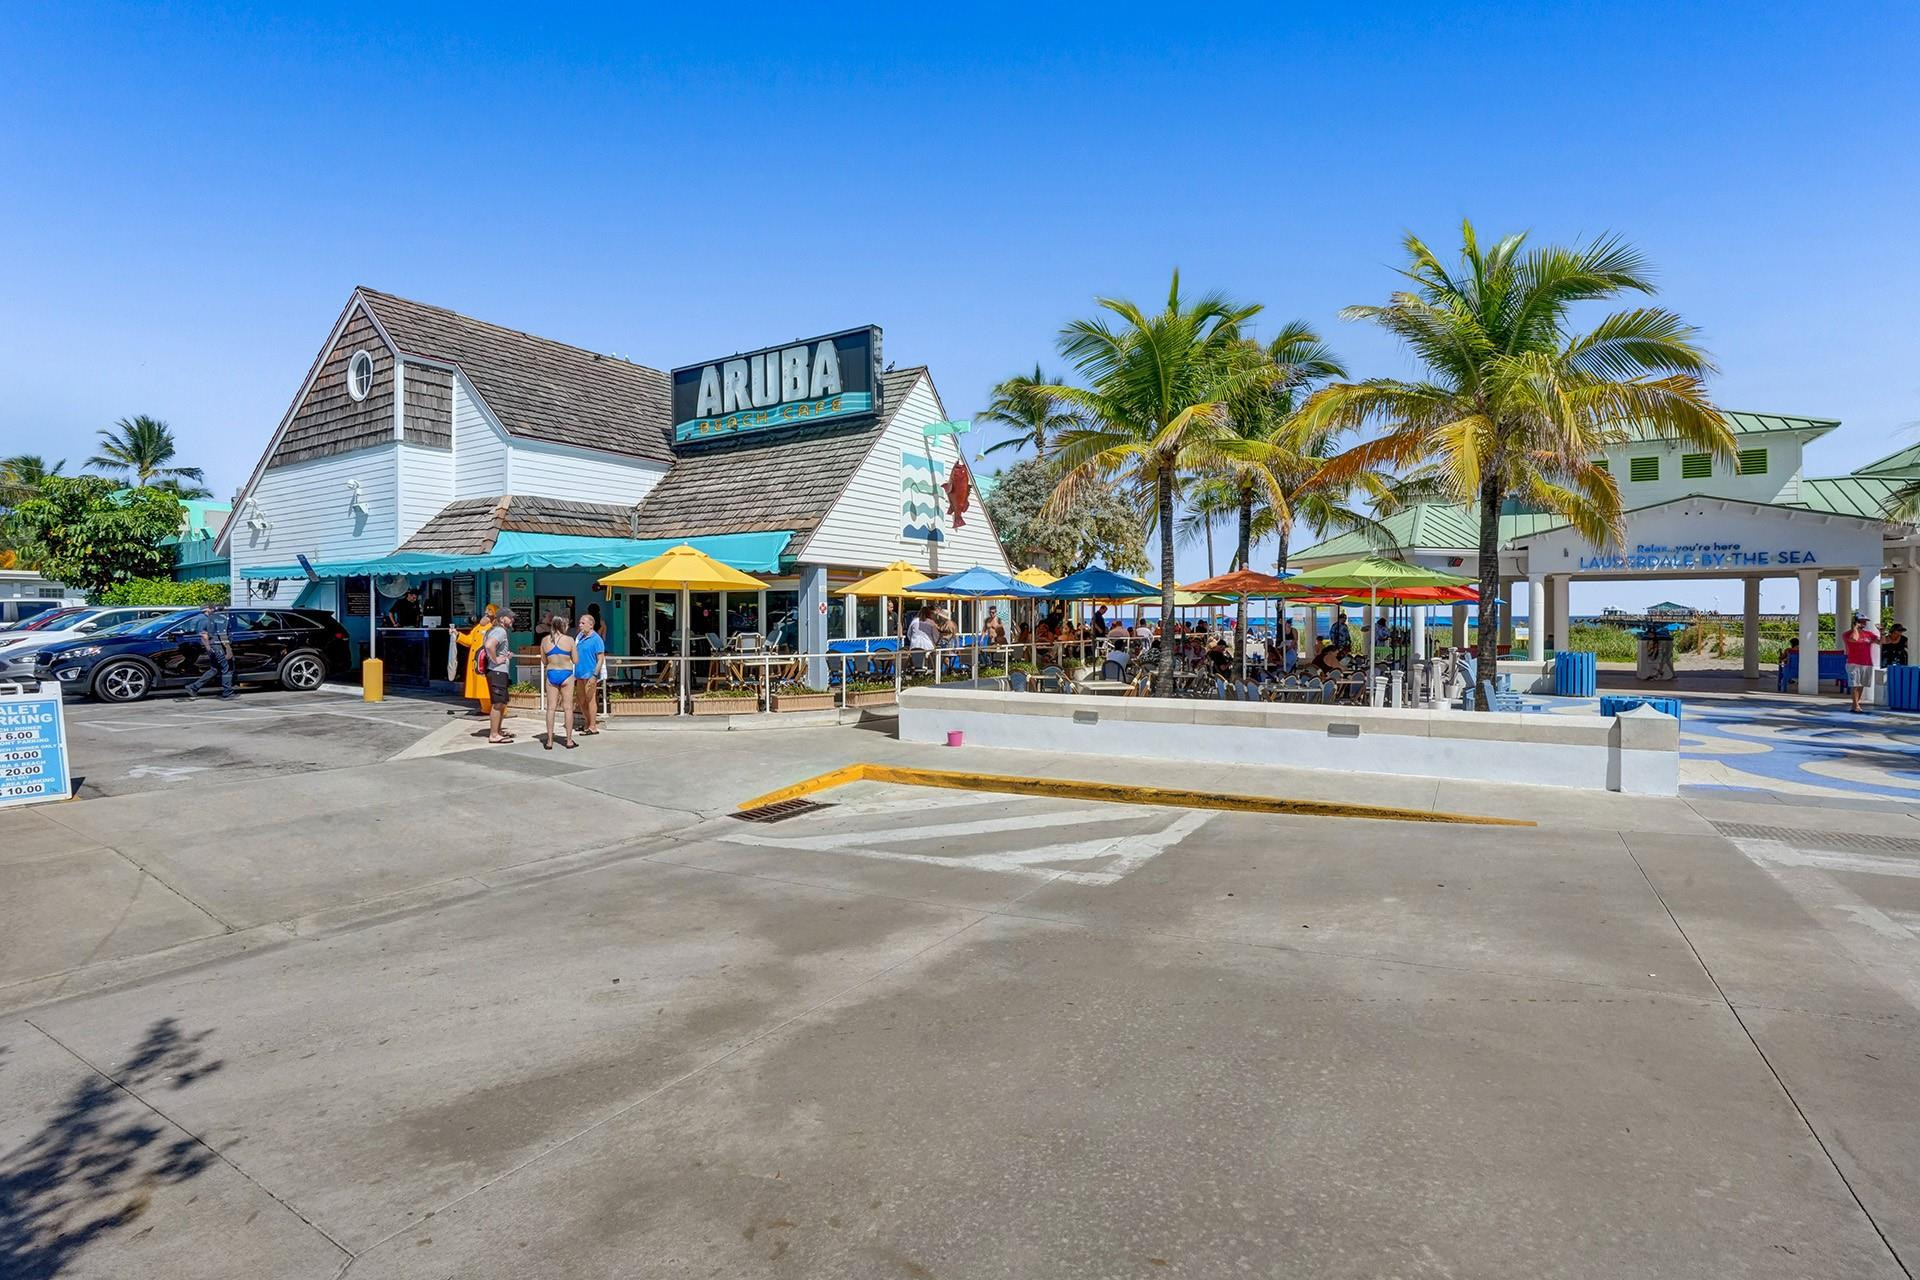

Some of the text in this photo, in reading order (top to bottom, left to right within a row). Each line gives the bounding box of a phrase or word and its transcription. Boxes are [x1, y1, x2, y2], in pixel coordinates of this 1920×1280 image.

[696, 340, 841, 418] ARUBA
[700, 398, 842, 433] BEACH CAFE
[1713, 542, 1740, 551] here
[1702, 553, 1725, 567] BY
[1732, 552, 1769, 566] THE
[1778, 551, 1816, 564] SEA
[6, 731, 33, 740] 6.00
[5, 751, 38, 760] 10.00
[6, 766, 40, 776] 20.00
[23, 777, 56, 785] PARKING
[8, 785, 42, 795] 10.00
